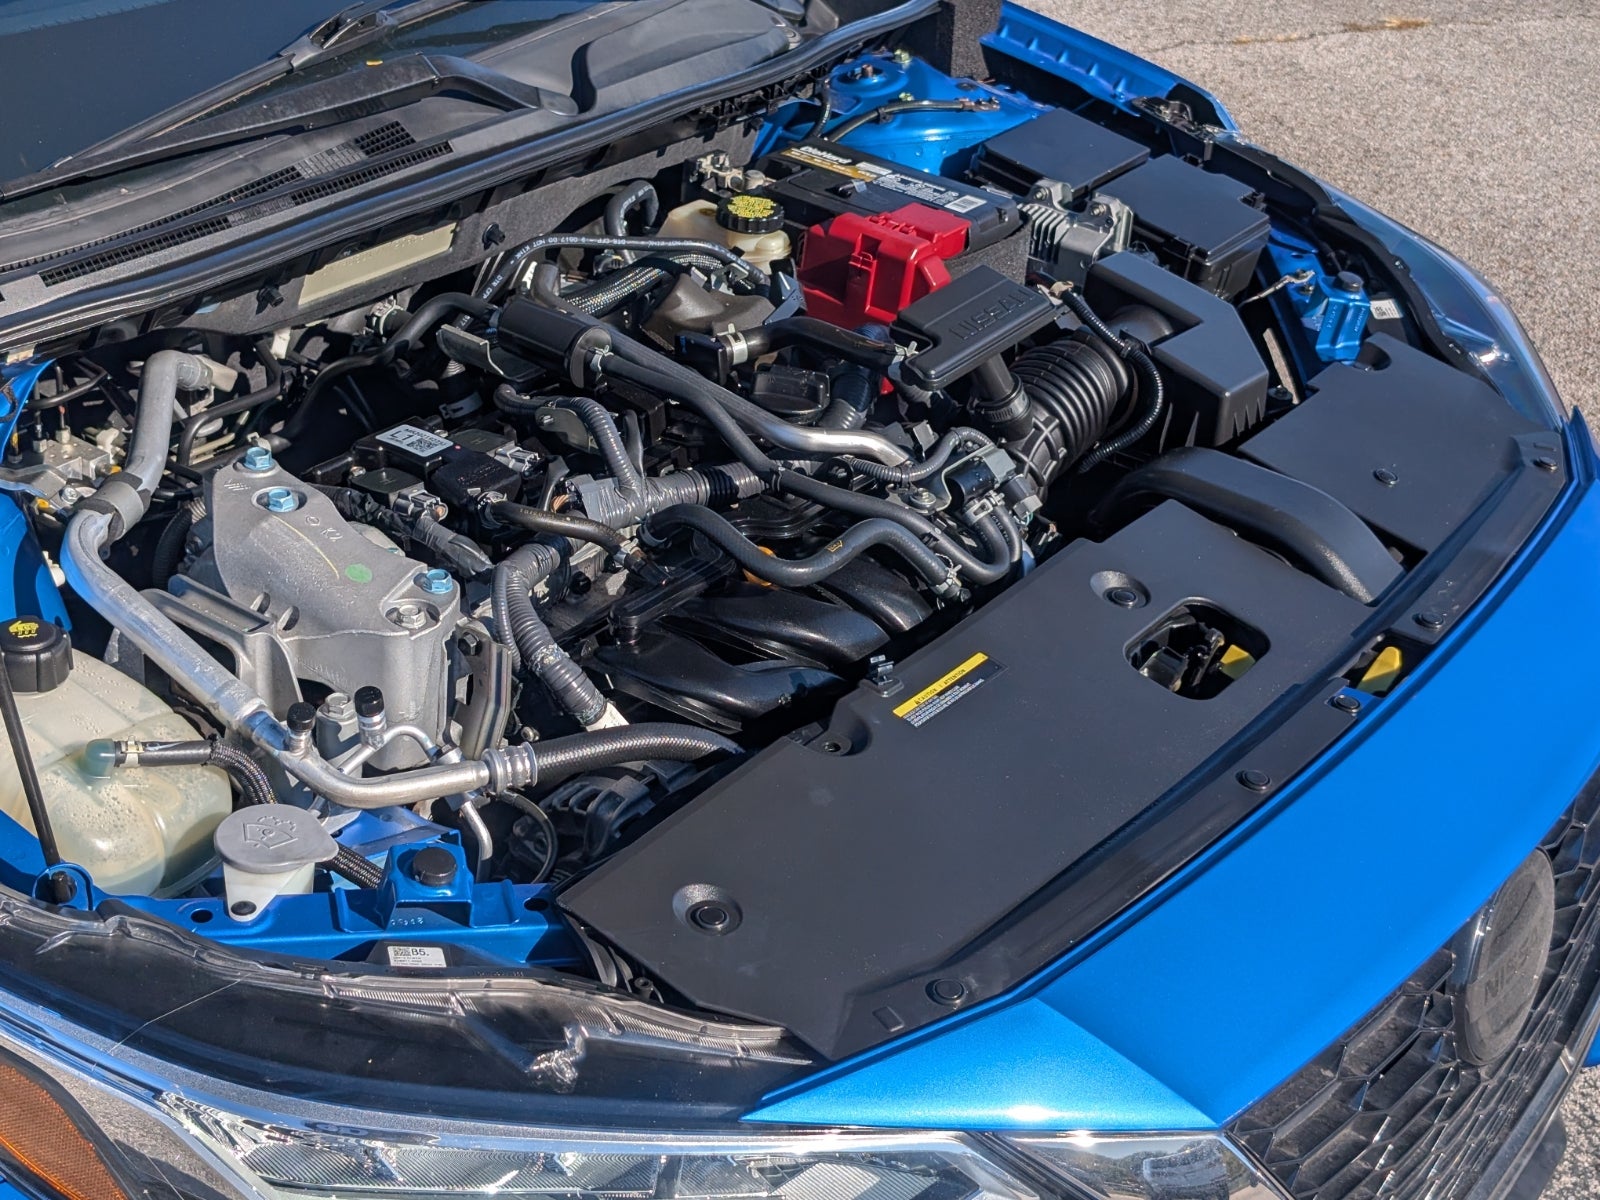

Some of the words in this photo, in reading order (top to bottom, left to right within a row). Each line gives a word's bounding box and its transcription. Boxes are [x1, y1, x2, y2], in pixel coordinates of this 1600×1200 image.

[800, 146, 852, 164] DieHard
[533, 239, 545, 248] NOT
[514, 245, 531, 260] KINK
[918, 688, 938, 703] CAUTION
[943, 669, 966, 685] ATTENTION
